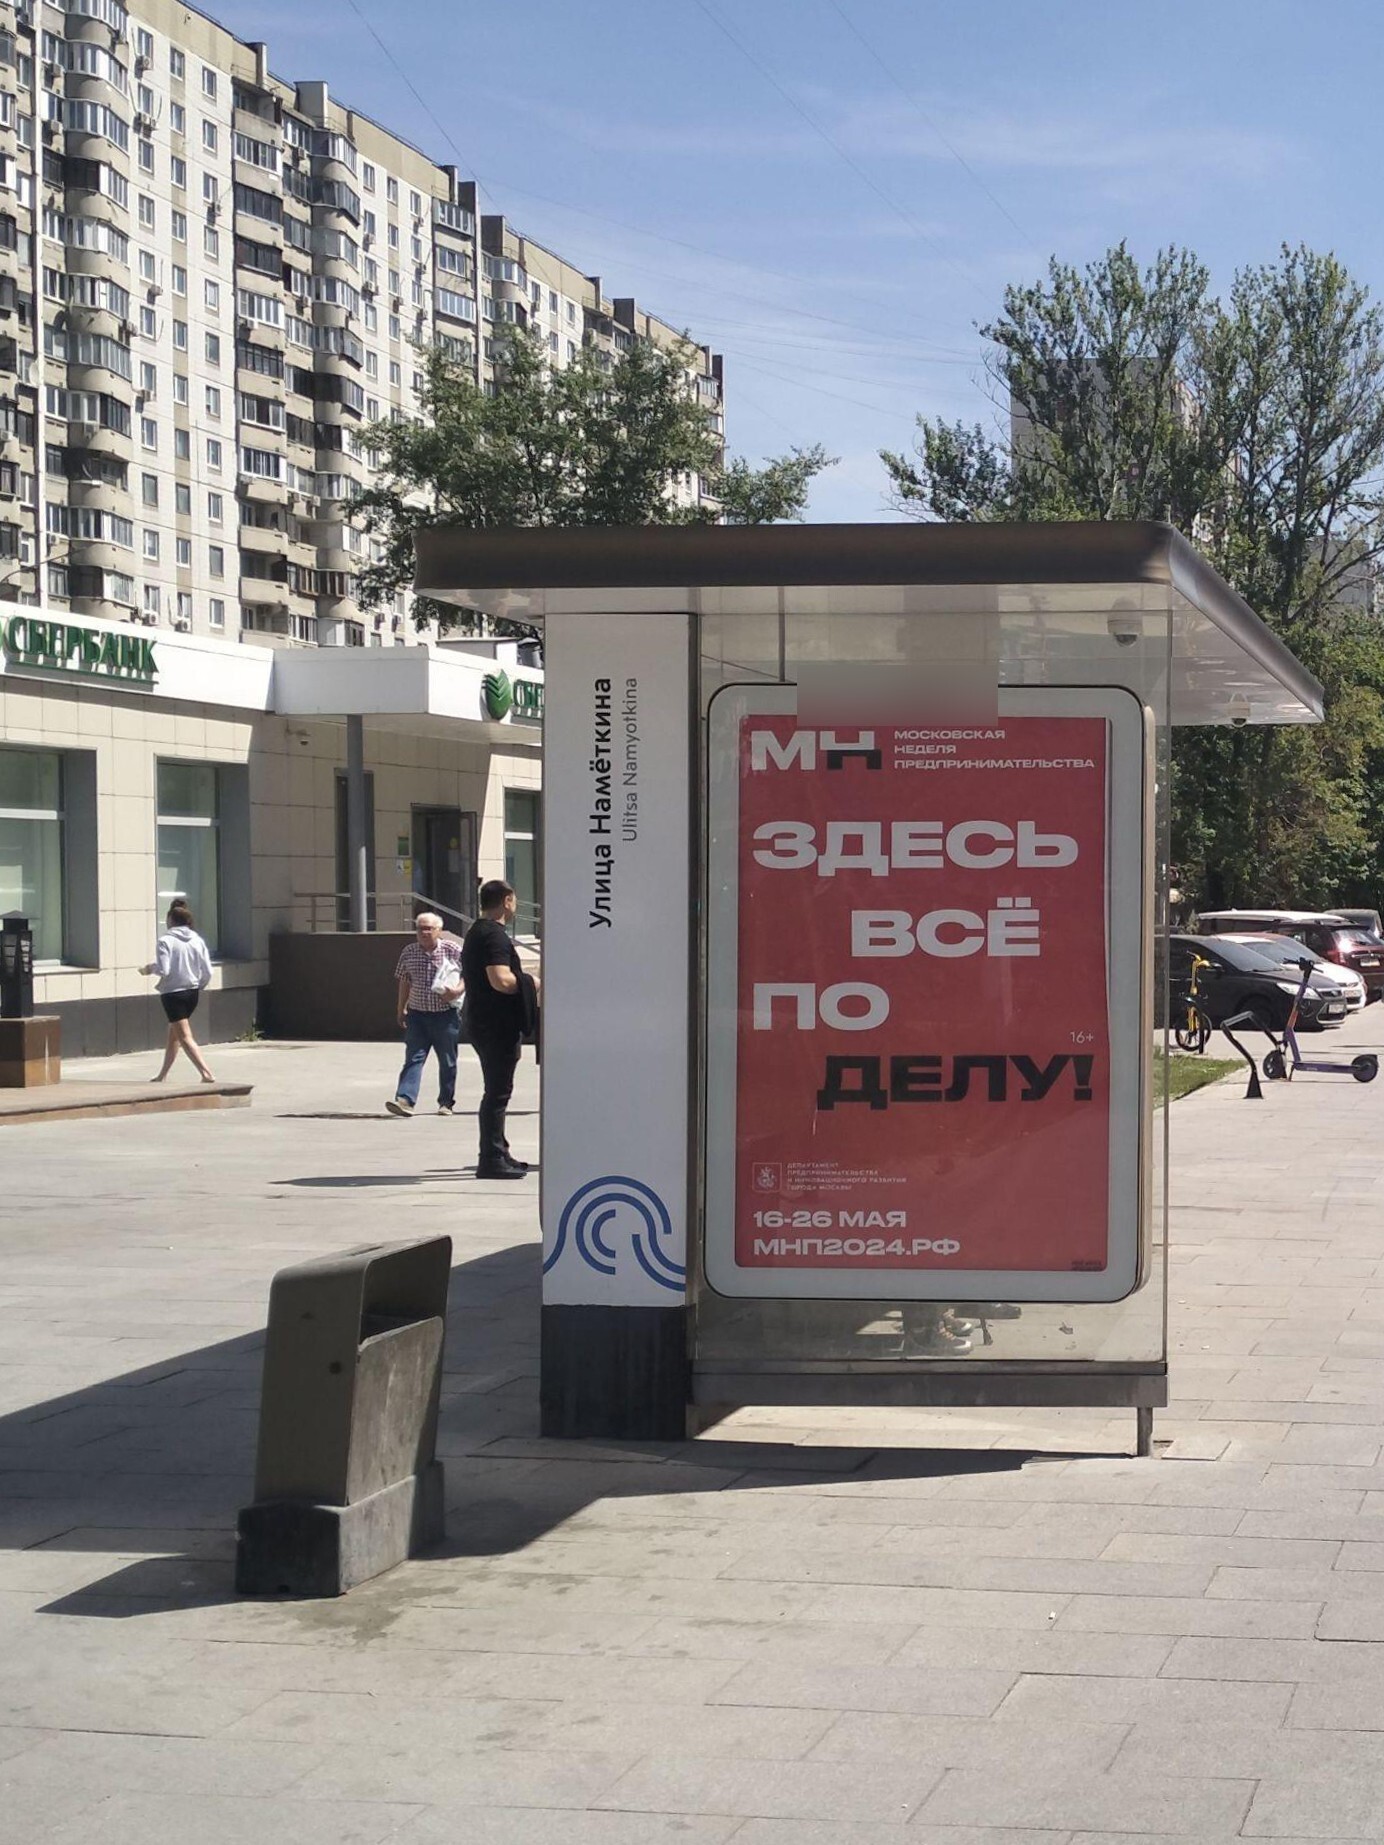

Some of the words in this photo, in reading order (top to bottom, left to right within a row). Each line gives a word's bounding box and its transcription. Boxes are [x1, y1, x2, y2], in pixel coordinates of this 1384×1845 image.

[8, 616, 159, 673] СБЕРБАНК
[589, 678, 612, 835] Намёткина
[622, 677, 641, 786] Namyotkina
[894, 730, 1006, 740] МОСКОВСКАЯ
[894, 745, 957, 755] НЕДЕЛЯ
[894, 759, 1095, 770] ПРЕДПРИНИМАТЕЛЬСТВА
[622, 791, 638, 842] Ulitsa
[752, 820, 1079, 877] ЗДЕСЬ
[589, 843, 615, 928] Улица
[851, 896, 1041, 957] ВСЁ
[753, 982, 890, 1031] ПО
[1070, 1030, 1095, 1045] 16+
[816, 1054, 1095, 1111] ДЕЛУ!
[753, 1210, 833, 1228] 16-26
[838, 1210, 907, 1228] МАЯ
[753, 1237, 961, 1256] МНП2024.РФ
